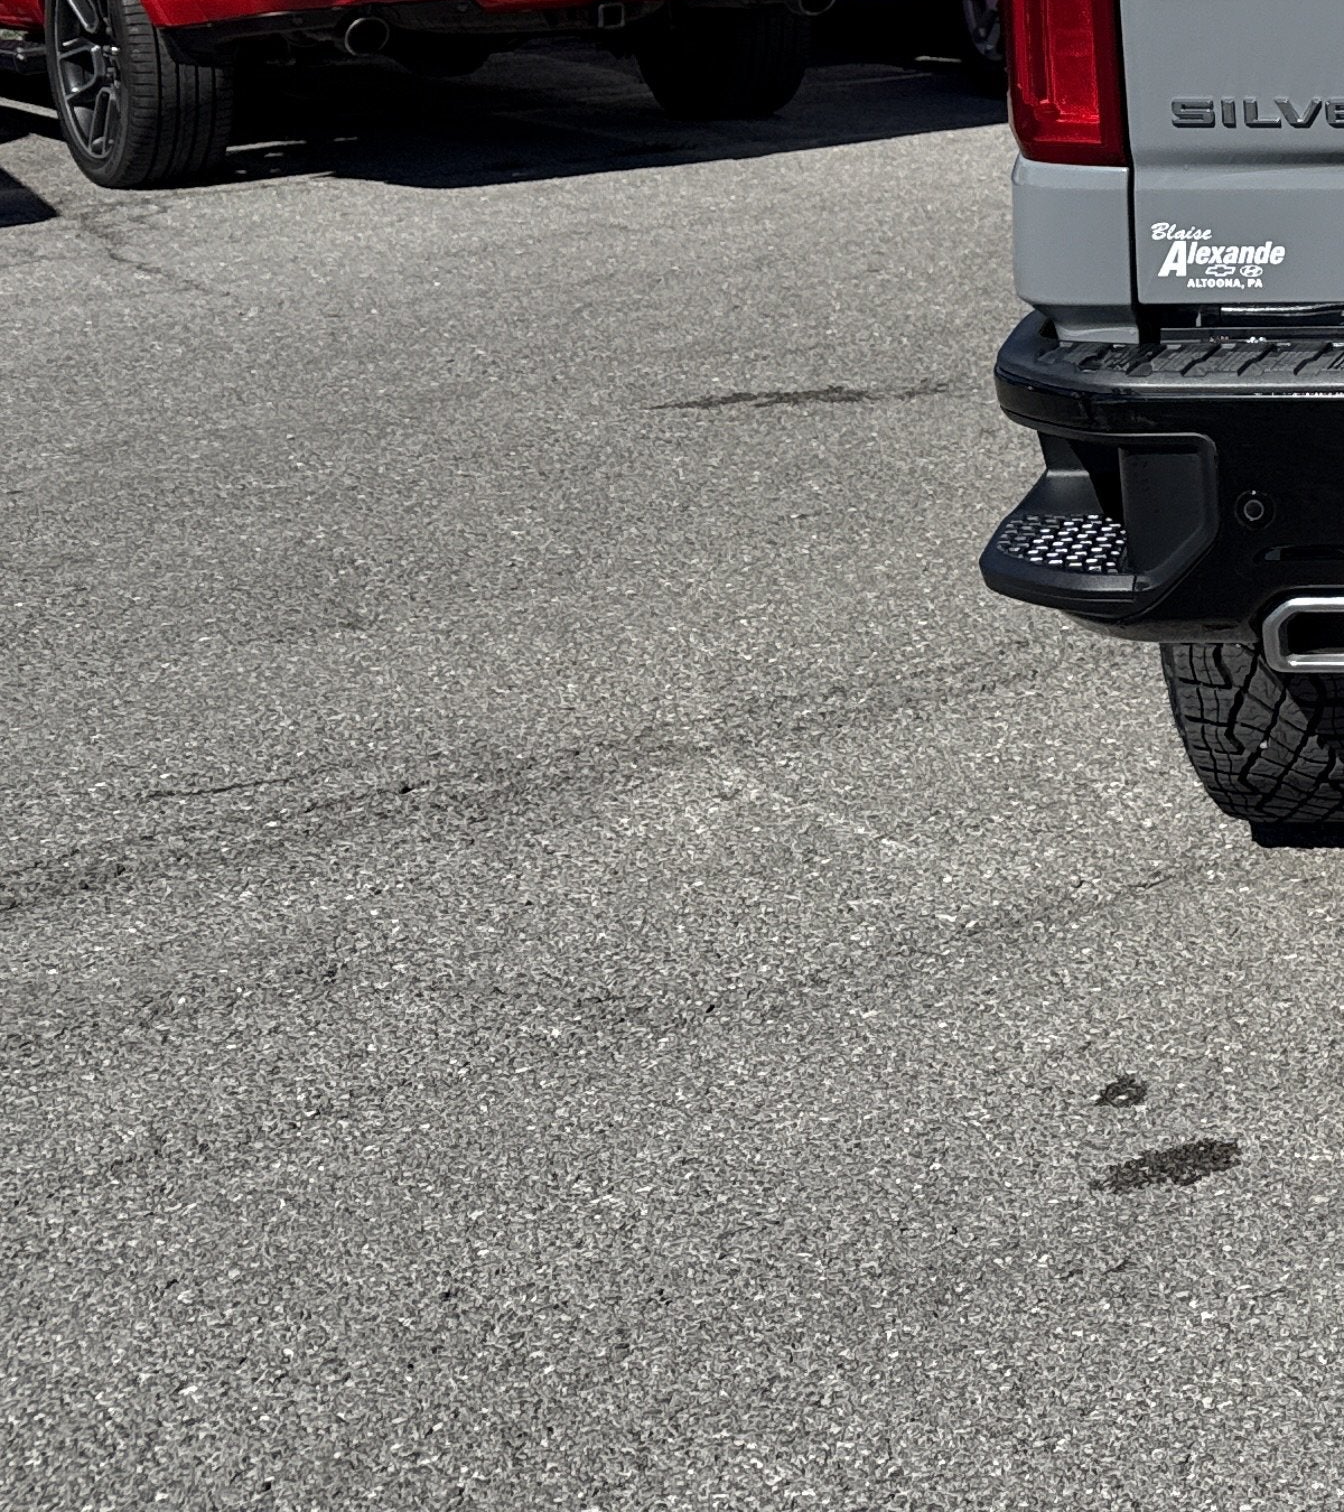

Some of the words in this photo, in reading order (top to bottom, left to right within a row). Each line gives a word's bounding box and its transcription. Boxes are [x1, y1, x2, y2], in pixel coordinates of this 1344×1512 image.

[1151, 222, 1212, 240] Blaise
[1158, 241, 1286, 277] Alexande
[1187, 278, 1245, 290] ALTOONA,
[1248, 278, 1263, 288] PA
